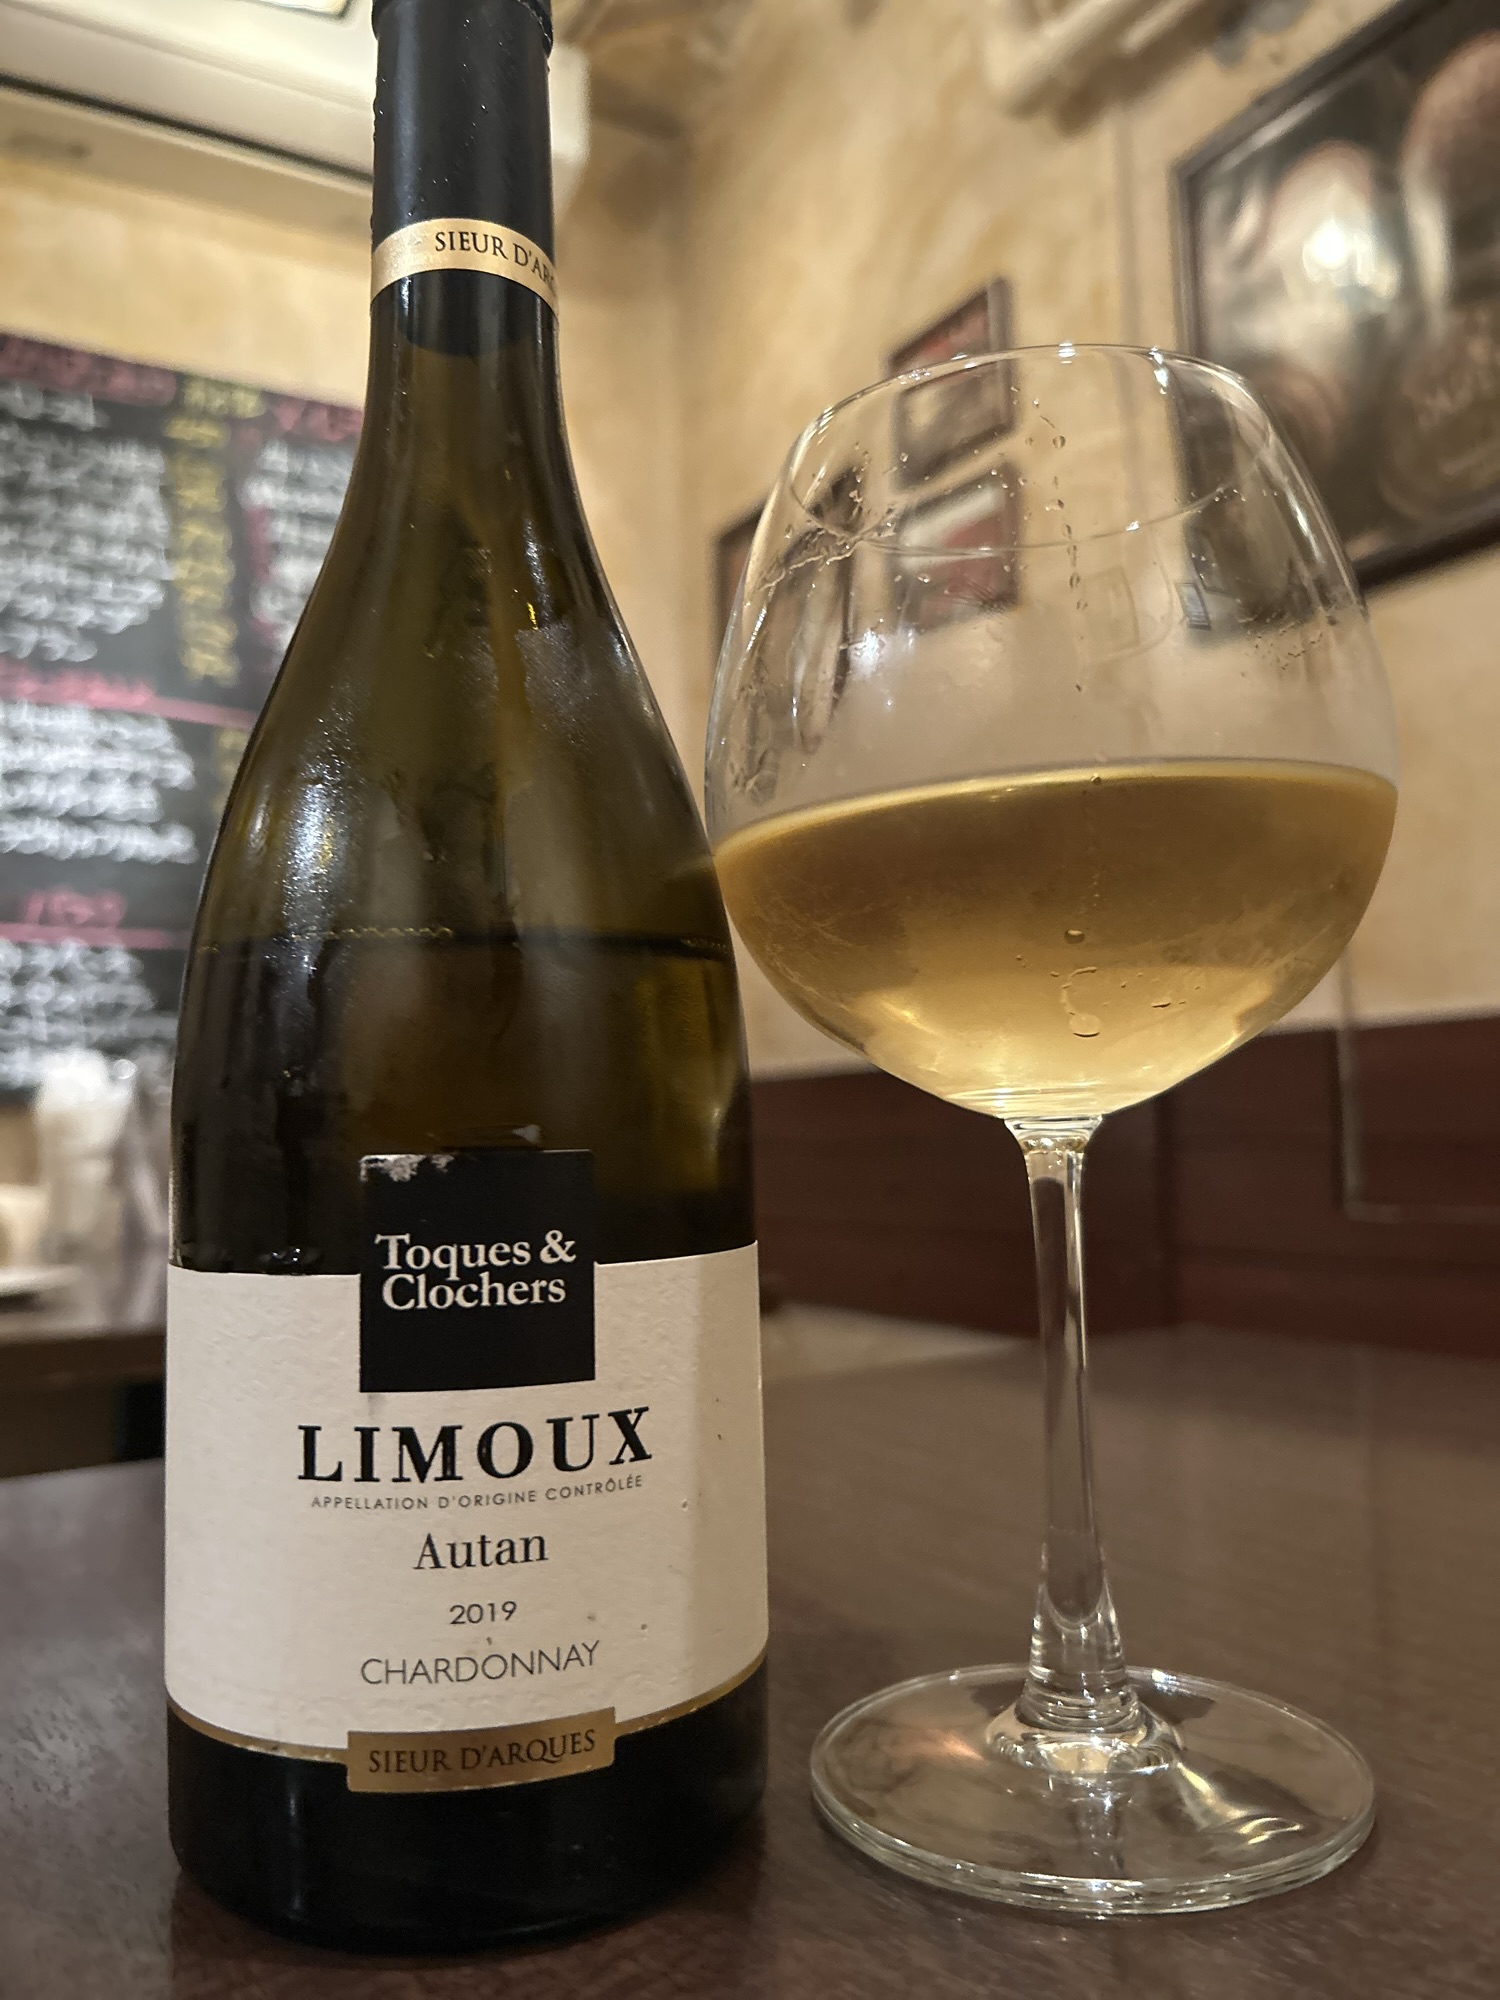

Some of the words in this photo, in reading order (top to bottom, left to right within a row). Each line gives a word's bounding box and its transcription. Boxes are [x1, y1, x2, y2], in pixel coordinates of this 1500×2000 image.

[435, 231, 508, 259] SIEUR
[374, 1233, 531, 1281] Toques
[539, 1229, 577, 1264] &
[382, 1271, 567, 1310] Clochers
[298, 1406, 653, 1483] LIMOUX
[311, 1495, 429, 1510] APPELLATION
[438, 1489, 537, 1509] D'ORIGINE
[545, 1474, 643, 1501] CONTRÔLÉE
[413, 1533, 549, 1570] Autan
[449, 1600, 517, 1625] 2019
[360, 1640, 600, 1685] CHARDONNAY
[368, 1749, 453, 1774] SIEUR
[461, 1728, 596, 1771] D'ARQUES
